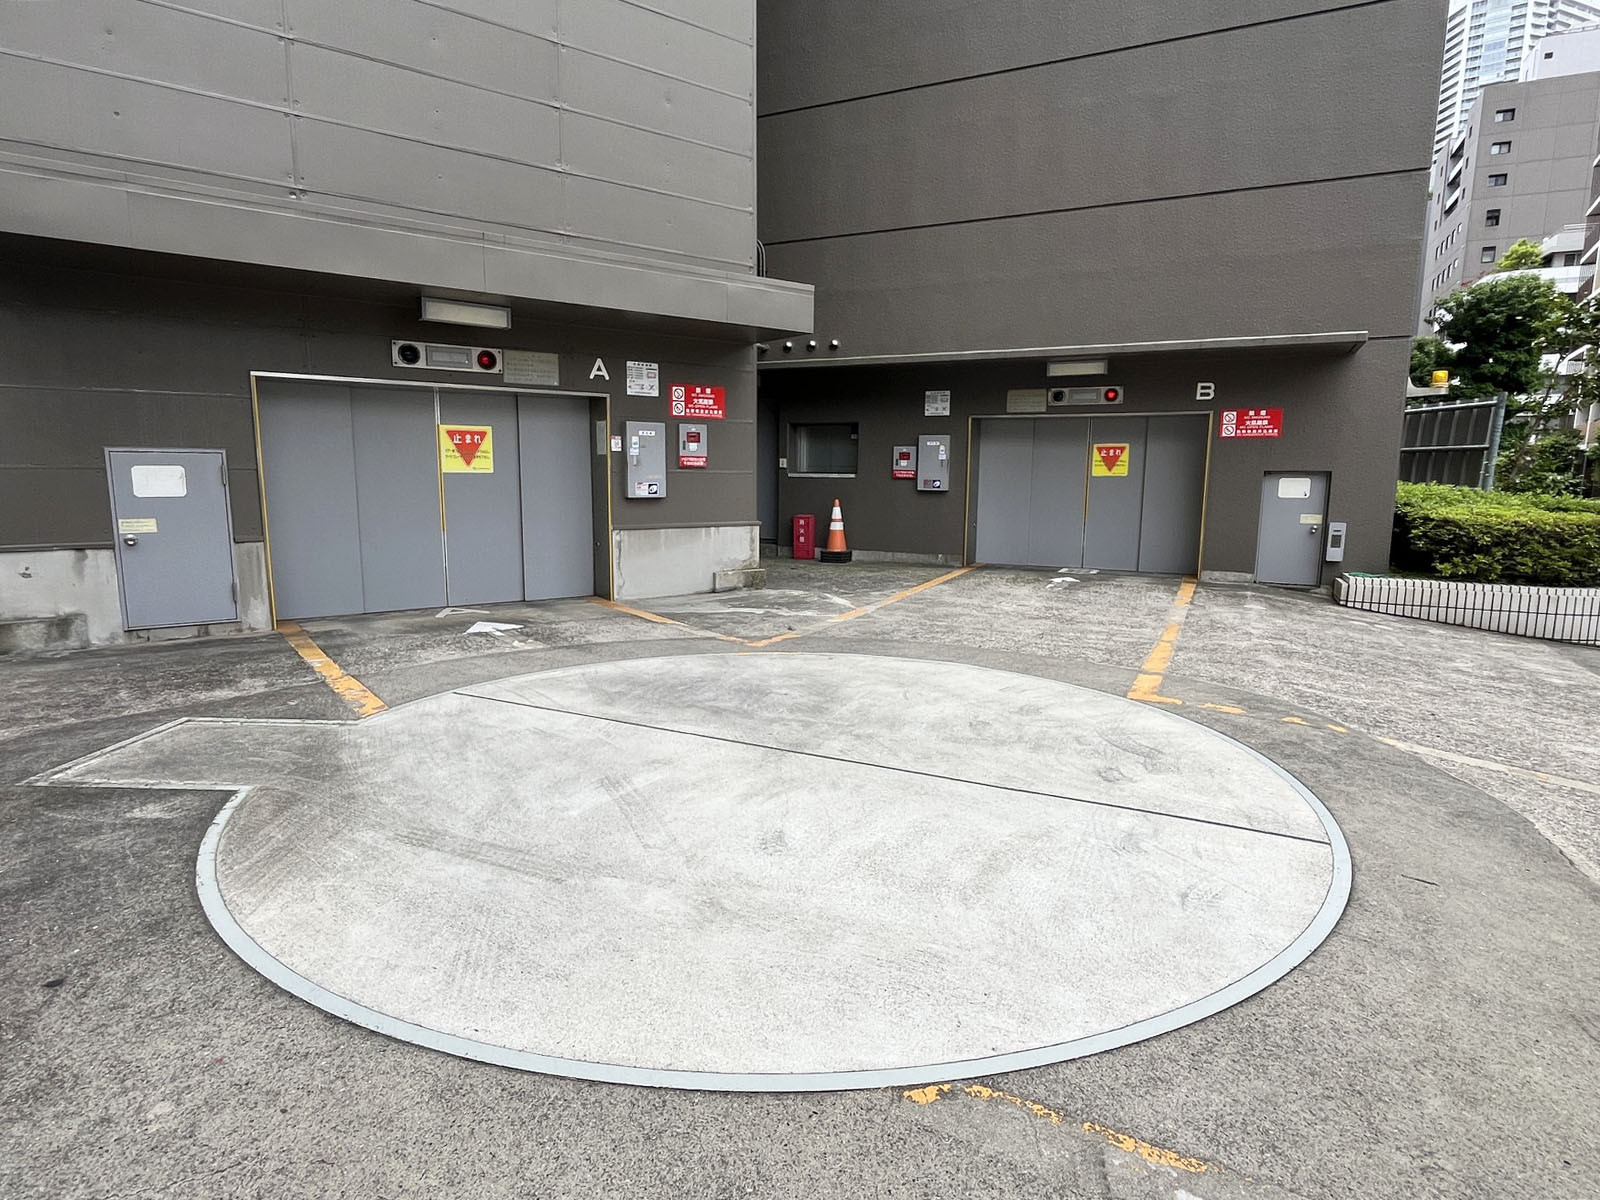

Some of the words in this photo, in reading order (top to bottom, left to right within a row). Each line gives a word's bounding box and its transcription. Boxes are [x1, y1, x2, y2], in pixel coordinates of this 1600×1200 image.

[590, 358, 609, 380] A
[1196, 382, 1215, 400] B
[453, 433, 482, 444] 止まれ
[1100, 449, 1122, 457] 止まれ
